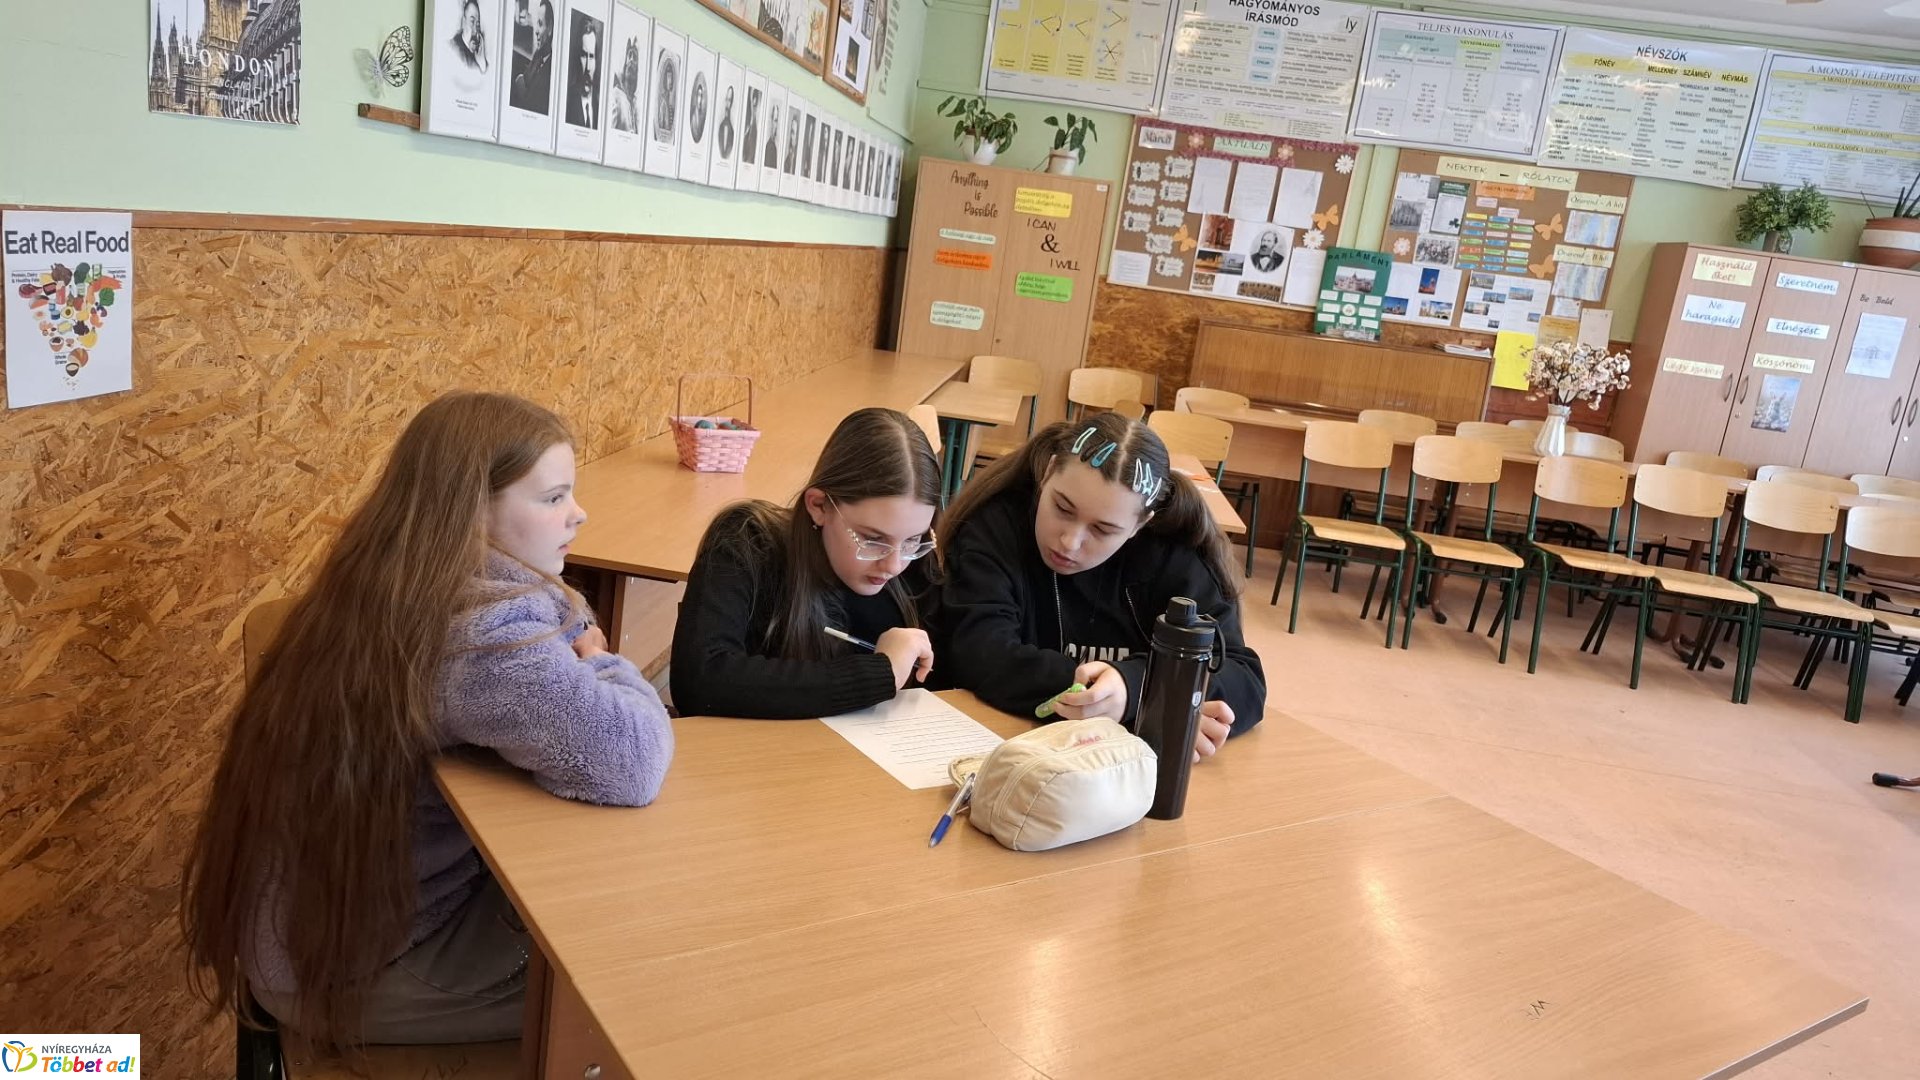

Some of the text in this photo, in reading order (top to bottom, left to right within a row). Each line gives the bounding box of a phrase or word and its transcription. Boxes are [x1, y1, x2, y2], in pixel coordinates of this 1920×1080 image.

[1245, 9, 1298, 26] ÍRÁSMÓD
[1417, 22, 1514, 40] TELJES HASONULÁS
[1636, 45, 1688, 62] NÉVSZÓK
[182, 45, 274, 80] LONDON
[1722, 73, 1748, 83] NÉVMÁS
[1446, 163, 1488, 174] NEKTEK
[950, 170, 988, 190] Anything
[964, 202, 998, 218] Possible
[1032, 218, 1056, 231] CAN
[5, 230, 129, 254] Eat Real Food
[1040, 234, 1060, 254] &
[1056, 260, 1080, 272] WILL
[1328, 251, 1389, 266] PARLAMENT
